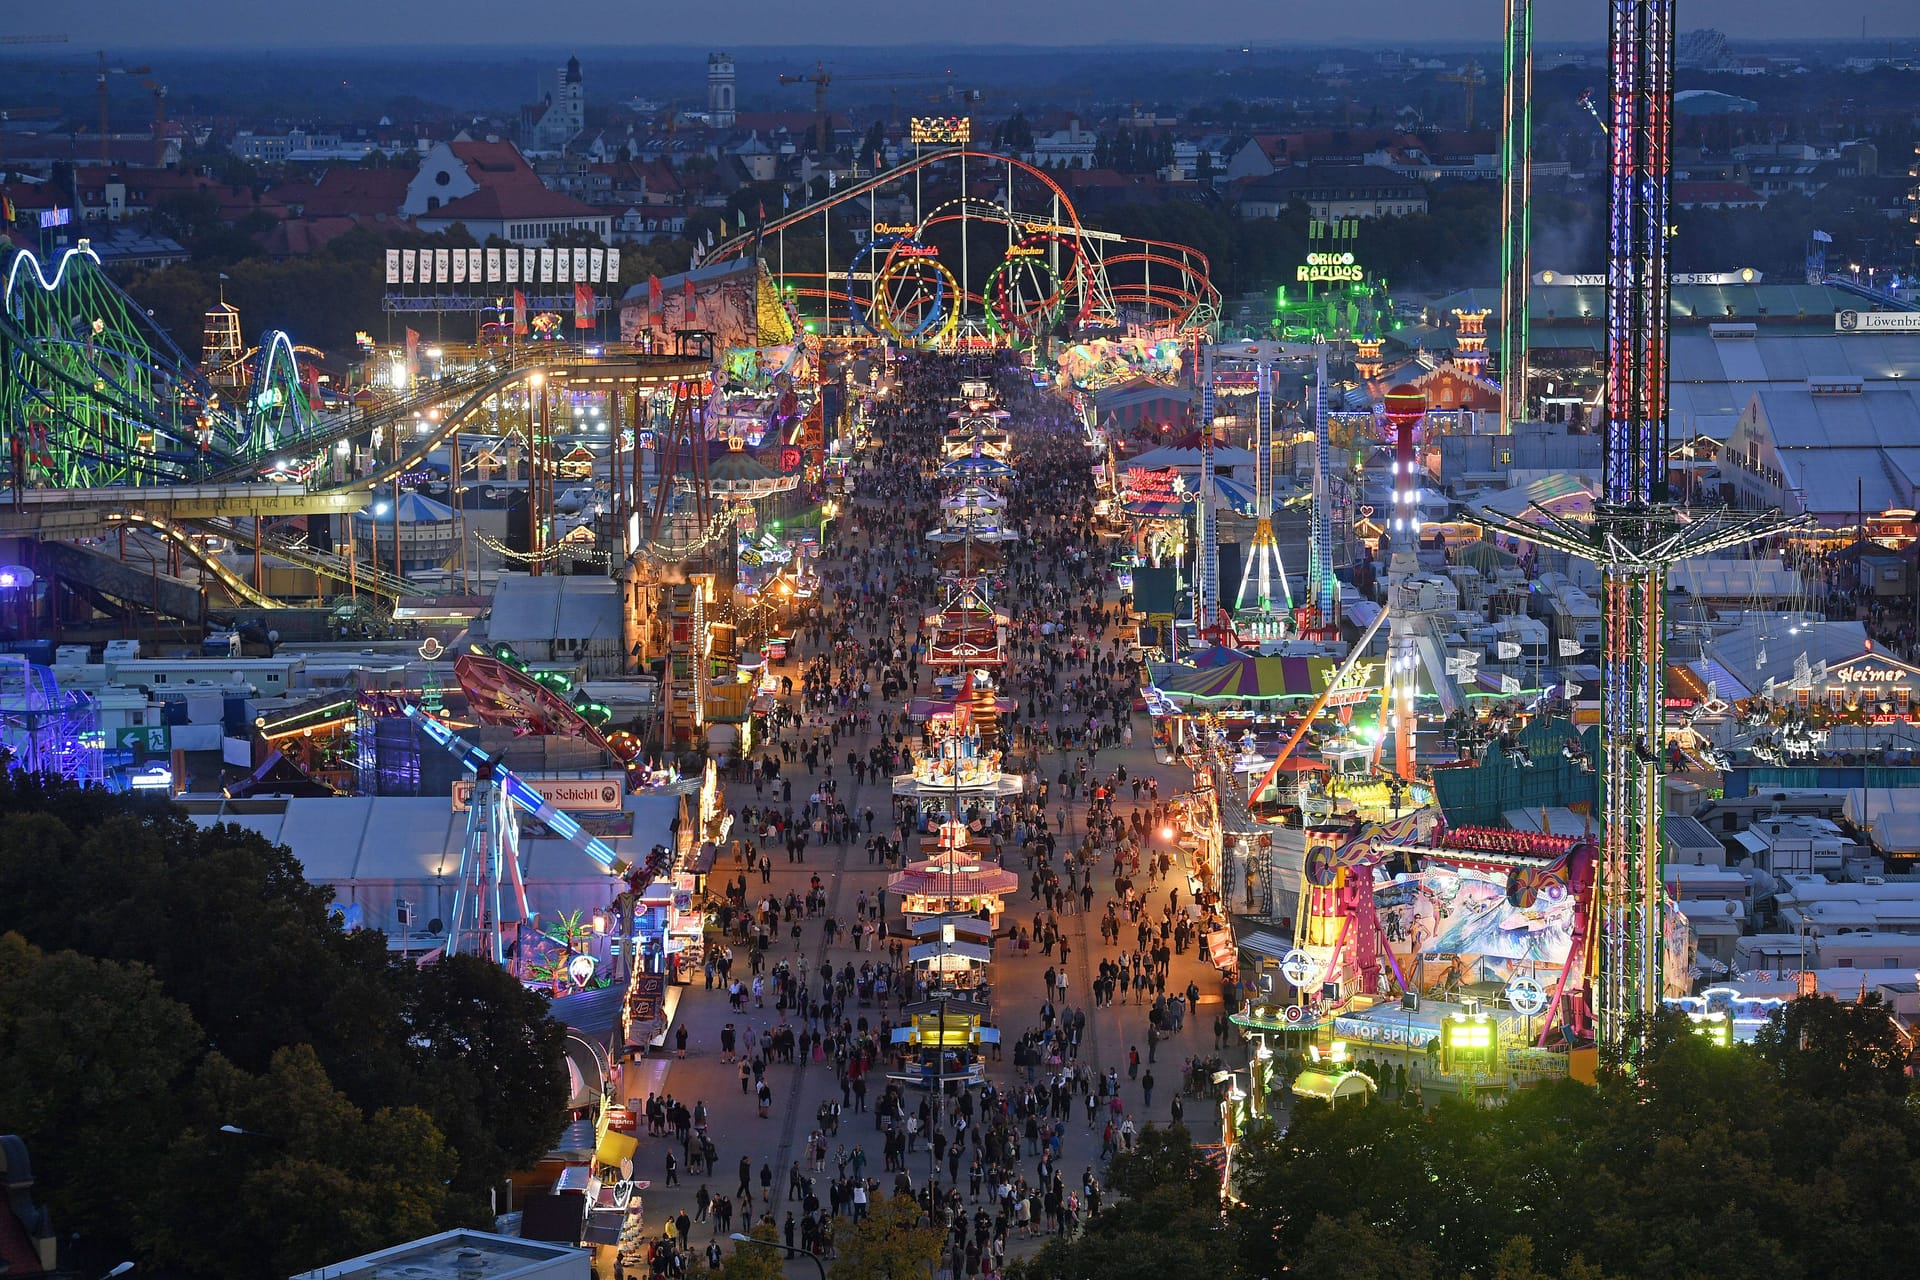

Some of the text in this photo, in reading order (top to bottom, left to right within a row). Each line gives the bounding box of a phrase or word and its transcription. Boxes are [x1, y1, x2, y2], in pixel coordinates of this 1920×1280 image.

[874, 222, 914, 234] Olympia
[1005, 245, 1045, 255] München
[1297, 265, 1363, 281] RAPIDOS
[1687, 273, 1722, 283] SEKT
[1837, 666, 1907, 683] Heimer
[556, 789, 598, 801] Schichtl
[1353, 1024, 1379, 1040] TOP
[1384, 1027, 1414, 1044] SPIN
